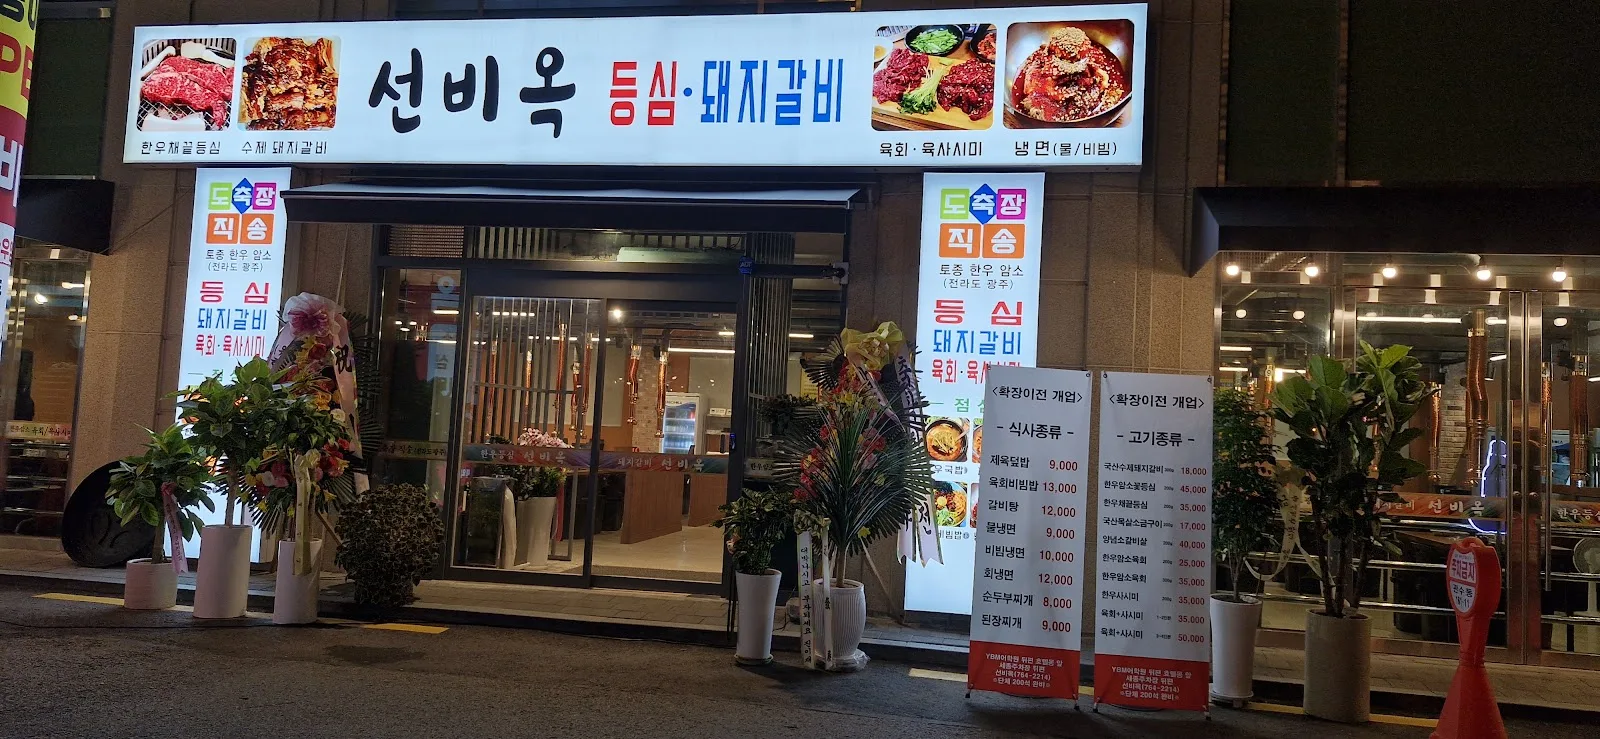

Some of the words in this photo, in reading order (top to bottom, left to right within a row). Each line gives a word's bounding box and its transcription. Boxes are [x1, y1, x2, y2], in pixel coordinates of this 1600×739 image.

[368, 46, 576, 139] 선비옥
[140, 141, 221, 155] 한우채끝등심
[241, 140, 267, 155] 수제
[272, 140, 328, 155] 돼지갈비
[211, 186, 275, 207] 도축장
[943, 193, 1025, 215] 도축장
[212, 217, 268, 240] 직송
[948, 228, 1017, 254] 직송
[205, 249, 225, 261] 토종
[229, 249, 248, 261] 한우
[253, 249, 272, 261] 암소
[207, 261, 238, 272] (전라도
[242, 261, 264, 272] 광주)
[939, 264, 963, 277] 토종
[970, 264, 993, 277] 한우
[1000, 264, 1024, 277] 암소
[943, 278, 981, 290] (전라도
[986, 278, 1014, 290] 광주)
[197, 308, 268, 331] 돼지갈비
[932, 329, 1021, 355] 돼지갈비
[1009, 421, 1062, 440] 식사종류
[1129, 431, 1182, 447] 고기종류
[990, 454, 1030, 469] 제육덮밥
[1049, 459, 1078, 471] 9,000
[1103, 462, 1164, 474] 국산수제돼지갈비
[1181, 467, 1207, 476] 18,000
[988, 476, 1038, 491] 육회비빔밥
[1042, 481, 1077, 494] 13,000
[1180, 485, 1207, 494] 45,000
[988, 499, 1019, 512] 갈비탕
[1041, 505, 1076, 517] 12,000
[1180, 503, 1206, 512] 35,000
[1428, 499, 1485, 516] 선비옥
[986, 521, 1016, 535] 물냉면
[1046, 527, 1075, 539] 9,000
[1180, 522, 1206, 531] 17,000
[1102, 535, 1148, 546] 양념소갈비살
[1179, 541, 1206, 549] 40,000
[985, 545, 1025, 559] 비빔냉면
[1039, 550, 1074, 562] 10,000
[1102, 553, 1147, 565] 한우암소육회
[1179, 559, 1205, 568] 25,000
[983, 568, 1014, 581] 회냉면
[1038, 573, 1073, 586] 12,000
[1452, 558, 1475, 581] 주차금지
[1102, 572, 1147, 583] 한우암소육회
[1179, 577, 1205, 587] 35,000
[982, 591, 1033, 606] 순두부찌개
[1042, 597, 1072, 609] 8,000
[1101, 590, 1139, 601] 한우사시미
[1178, 597, 1205, 605] 35,000
[981, 614, 1022, 629] 된장찌개
[1042, 620, 1071, 632] 9,000
[1101, 608, 1143, 620] 육회+사시미
[1178, 615, 1205, 624] 35,000
[1100, 627, 1143, 639] 육회+사시미
[1178, 634, 1205, 643] 50,000
